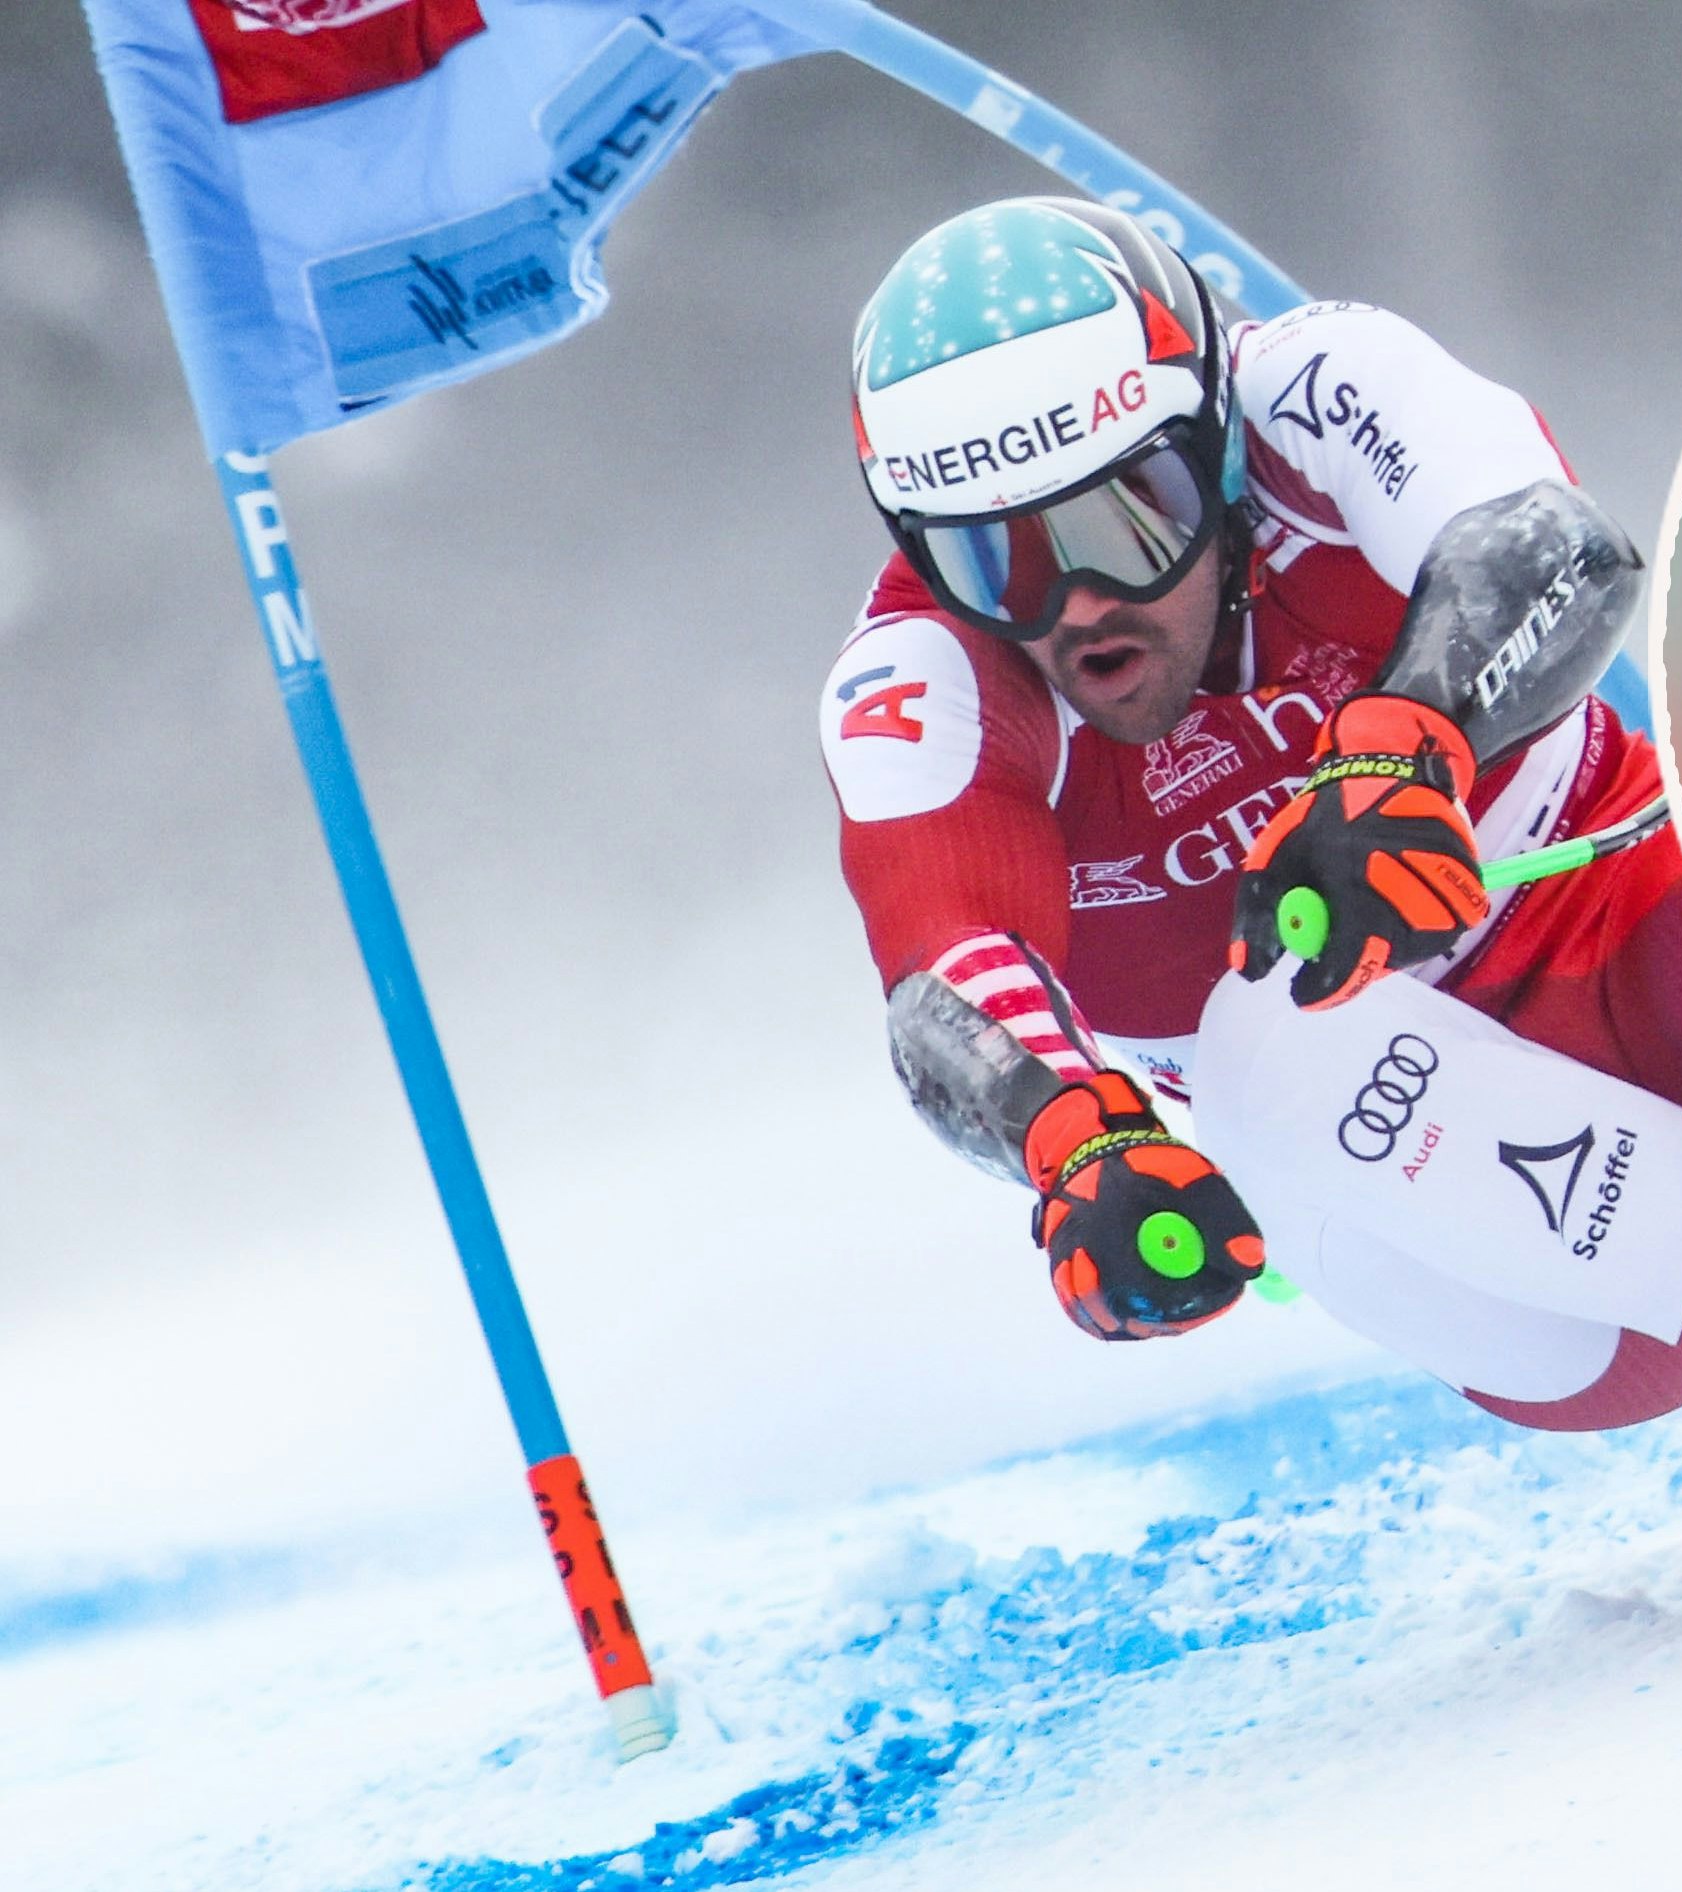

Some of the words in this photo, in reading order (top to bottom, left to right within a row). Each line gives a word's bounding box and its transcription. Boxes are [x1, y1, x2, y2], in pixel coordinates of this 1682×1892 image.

[885, 402, 1085, 492] ENERGIE
[1090, 369, 1147, 433] AG
[837, 665, 927, 743] A1
[1155, 754, 1244, 817] GENERALI
[1402, 1122, 1444, 1183] Audi
[1572, 1127, 1639, 1260] Schöffel
